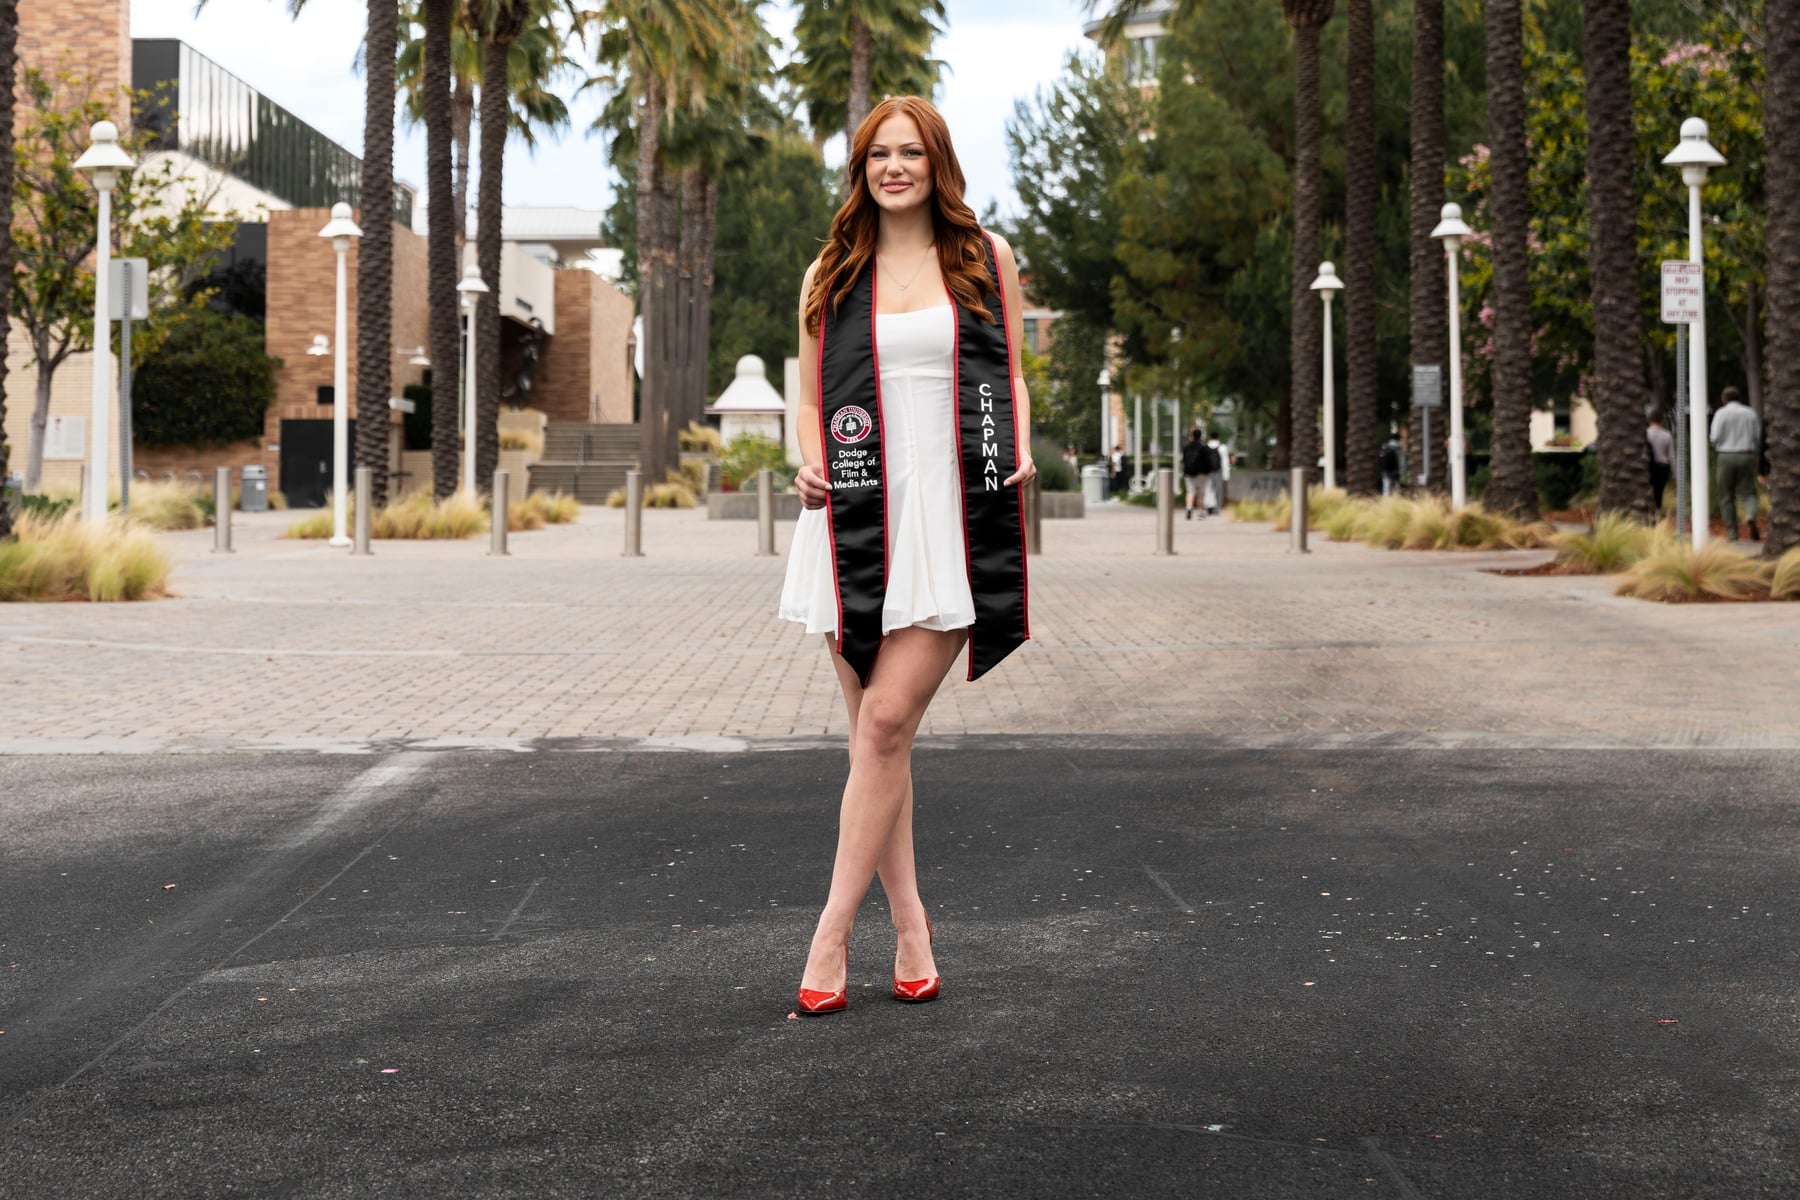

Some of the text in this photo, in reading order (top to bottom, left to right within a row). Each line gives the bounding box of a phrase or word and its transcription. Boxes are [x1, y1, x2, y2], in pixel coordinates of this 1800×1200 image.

[1674, 277, 1689, 285] NO
[1665, 287, 1699, 296] STOPPING
[978, 383, 999, 491] CHAPMAN
[838, 448, 868, 458] Dodge
[832, 456, 876, 469] College of
[841, 468, 869, 478] Film &
[833, 479, 878, 489] Media Arts
